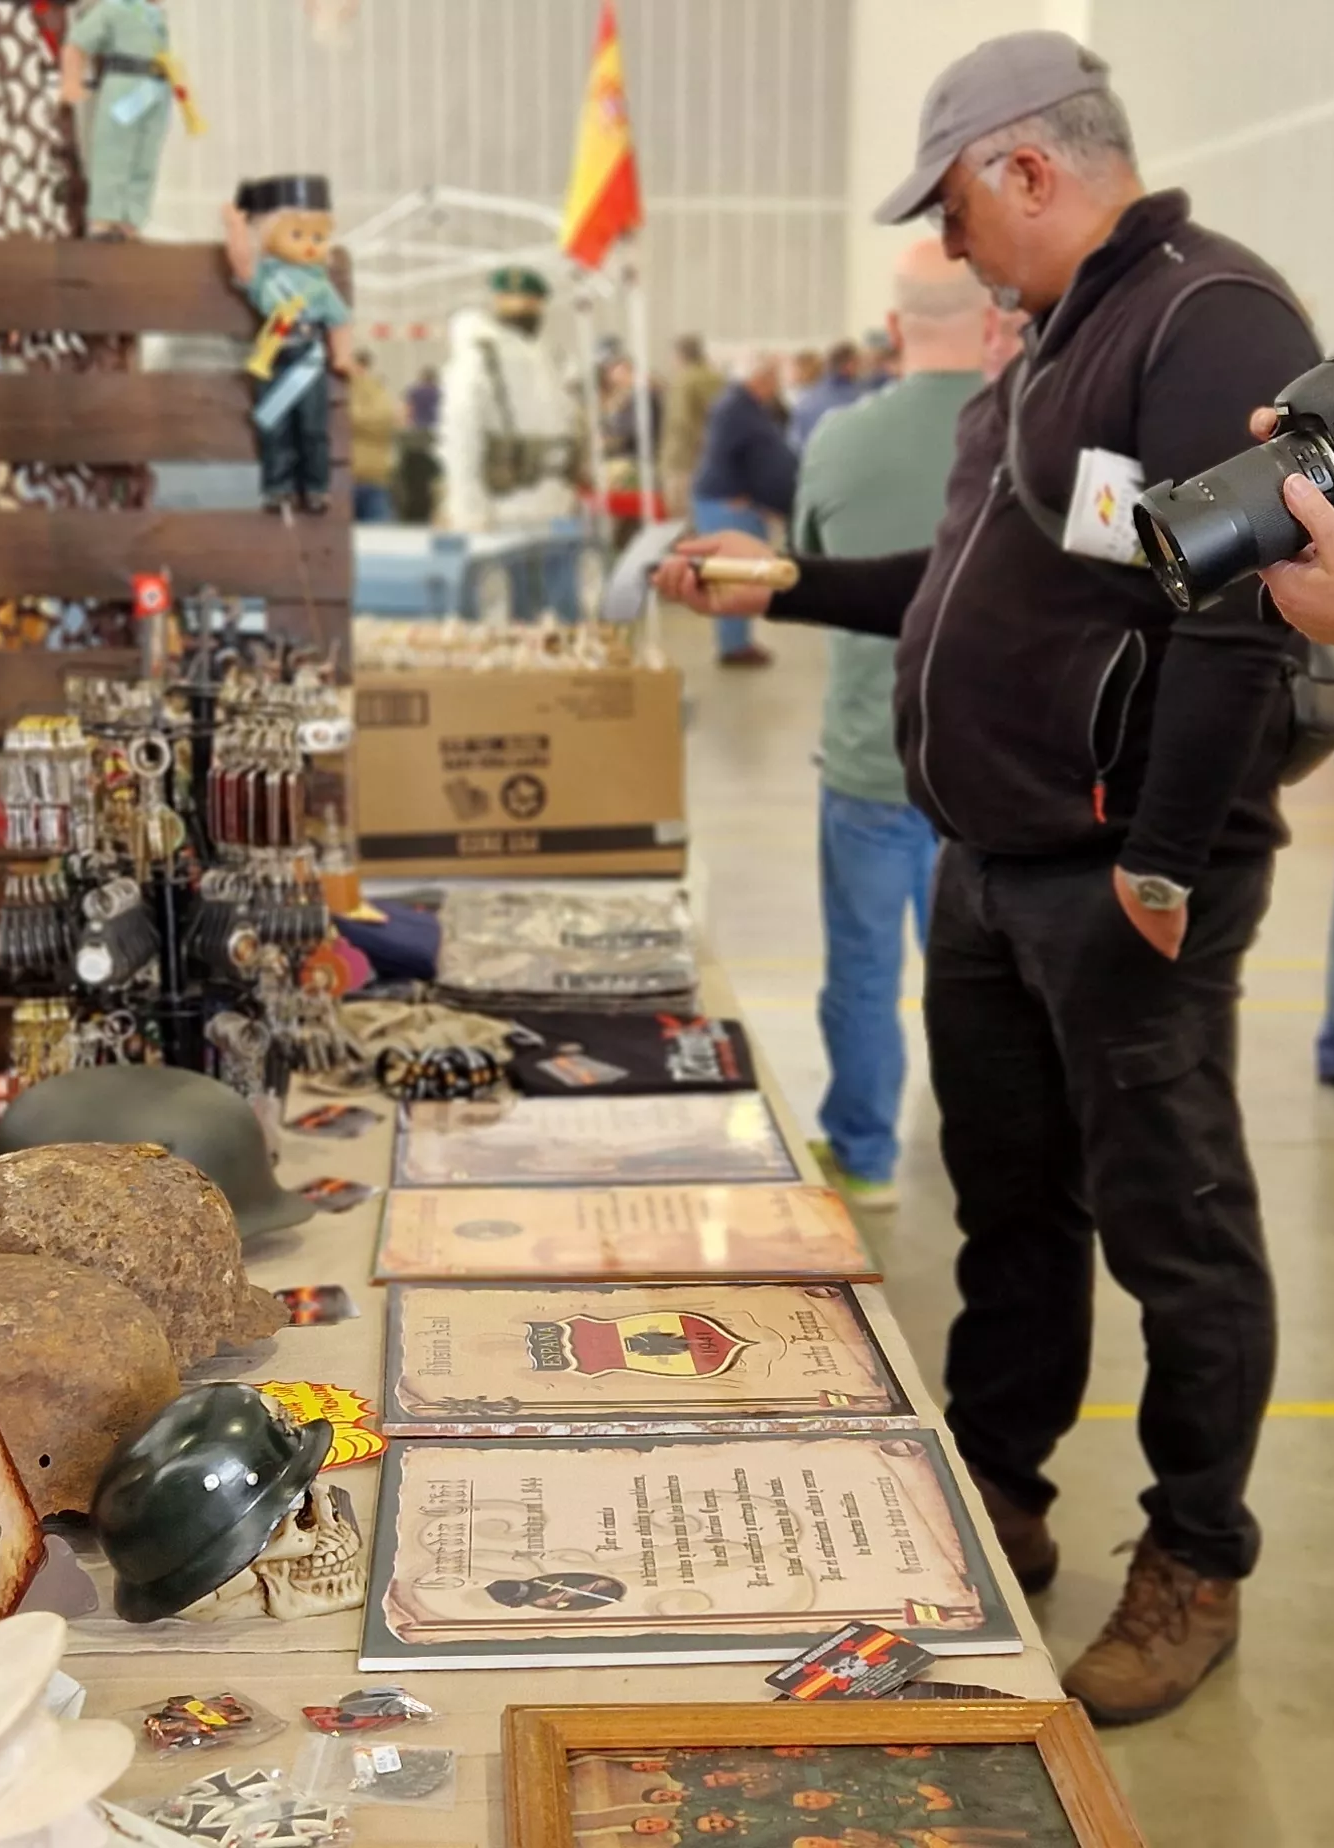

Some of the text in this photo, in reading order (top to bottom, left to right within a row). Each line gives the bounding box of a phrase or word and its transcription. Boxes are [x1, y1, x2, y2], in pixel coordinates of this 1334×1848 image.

[535, 1326, 563, 1367] ESPAÑA
[695, 1331, 720, 1356] 1941
[789, 1310, 835, 1345] España
[412, 1479, 468, 1589] Guardia Civil
